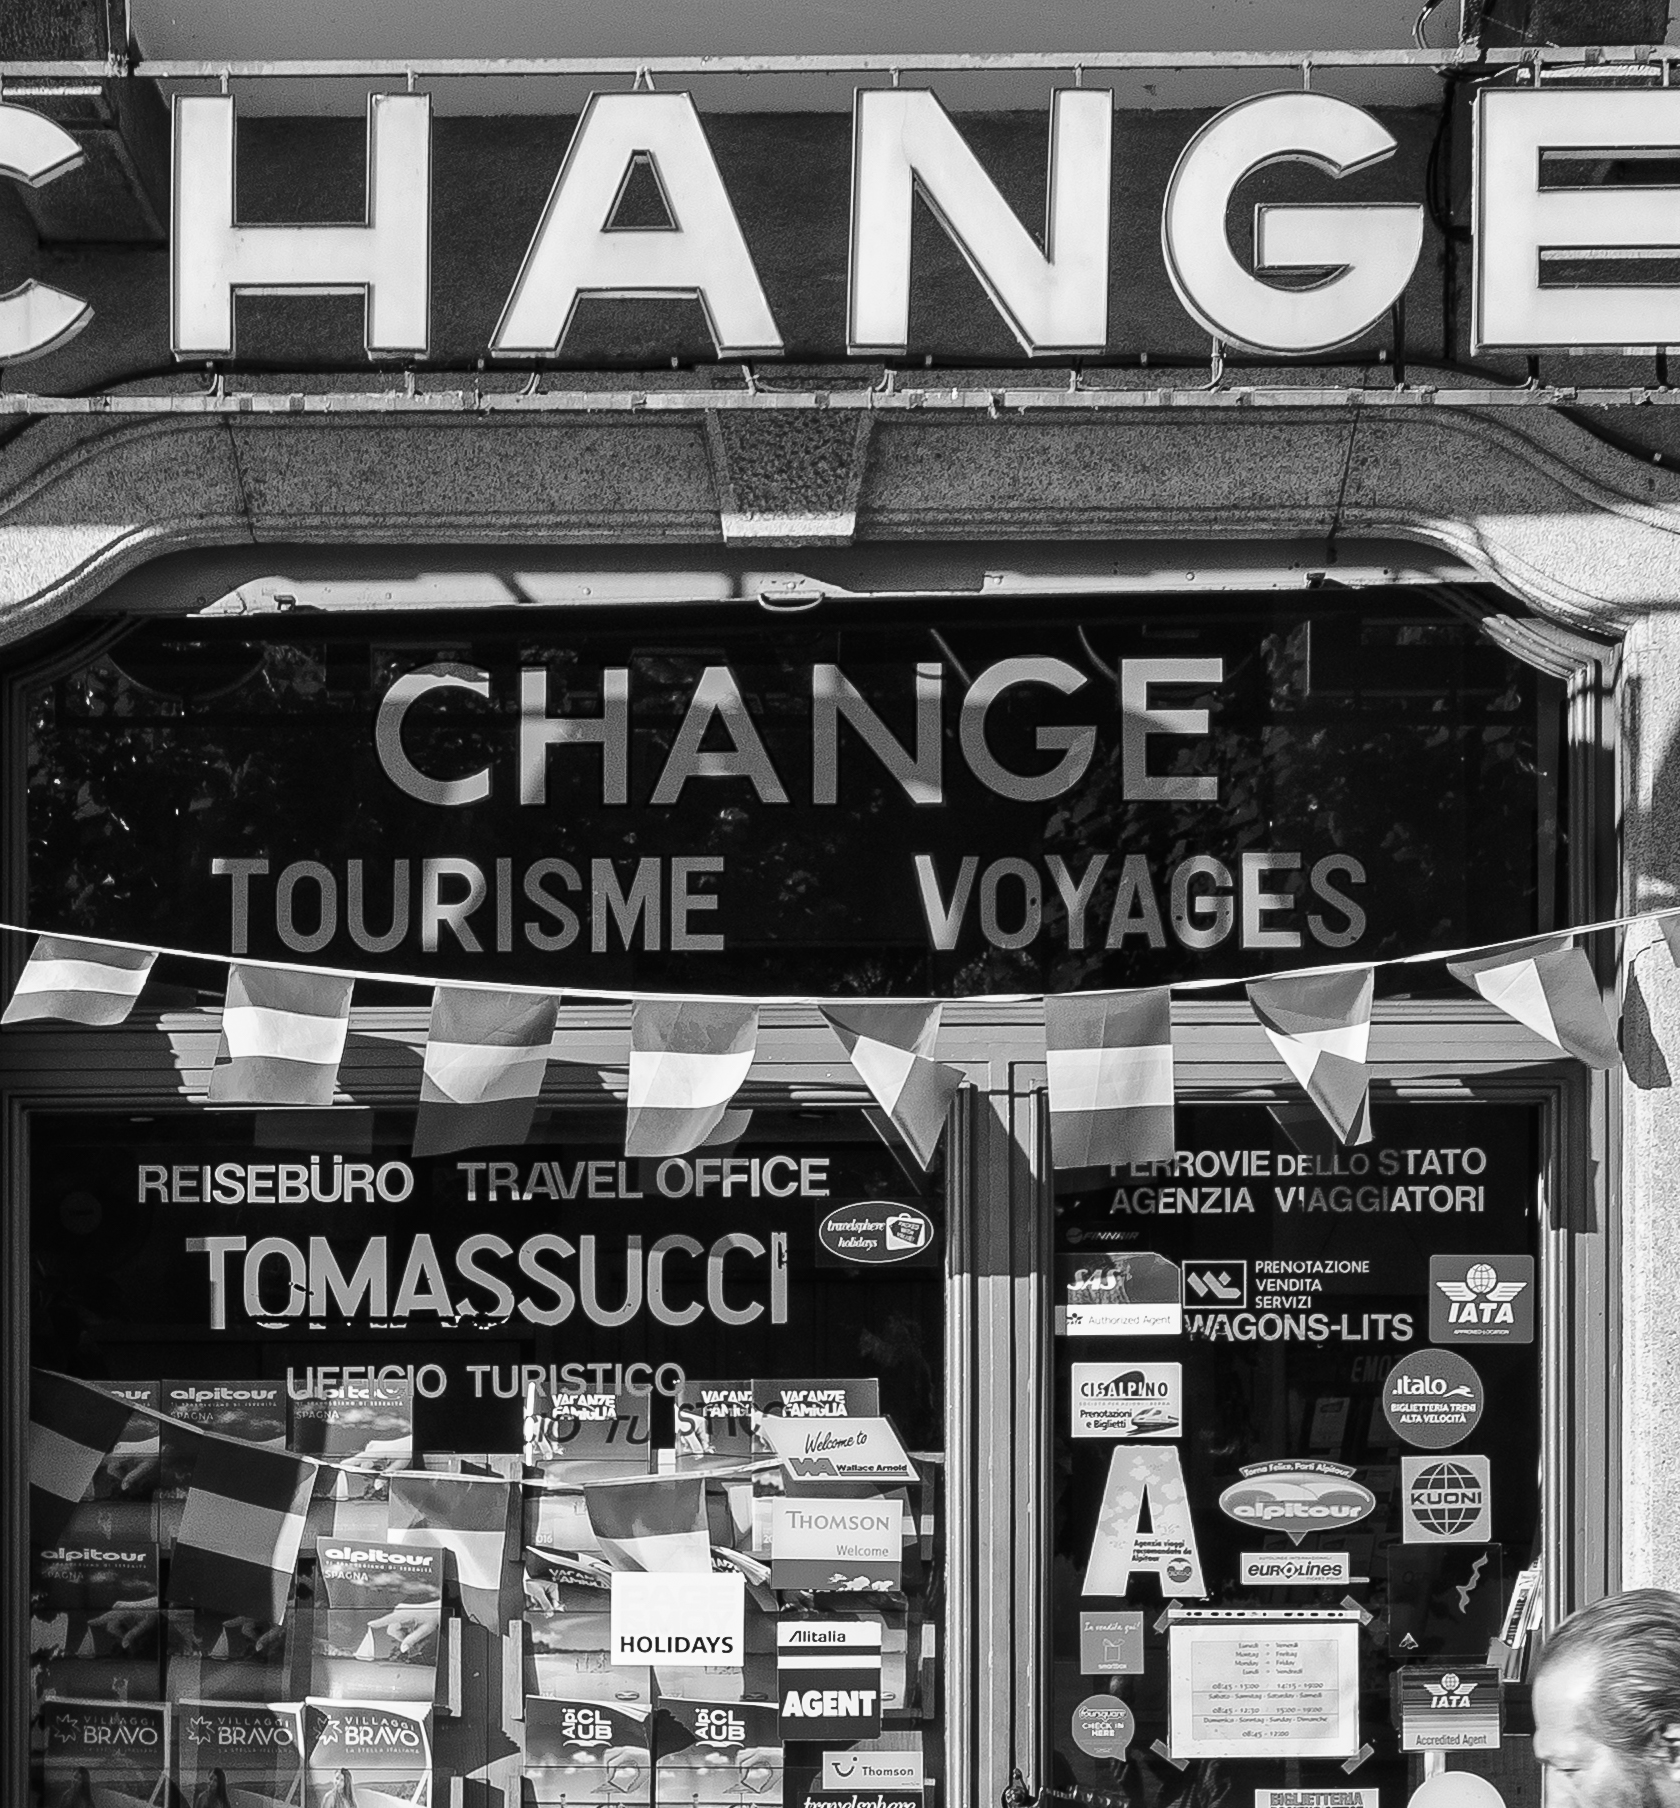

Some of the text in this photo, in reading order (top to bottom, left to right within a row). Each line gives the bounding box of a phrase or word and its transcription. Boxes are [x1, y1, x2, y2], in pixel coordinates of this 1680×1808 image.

[373, 657, 1225, 806] CHANGE
[211, 851, 1368, 955] TOURISME VOYAGES
[1276, 1154, 1370, 1177] DELLO
[1378, 1147, 1487, 1176] STATO
[137, 1154, 830, 1204] REISEBÜRO TRAVEL OFFICE
[1109, 1185, 1485, 1215] AGENZIA VIAGGIATORI
[838, 1237, 878, 1252] holidays
[1255, 1260, 1370, 1274] PRENOTAZIONE
[186, 1231, 789, 1331] TOMASSUCCI
[1067, 1268, 1121, 1290] SAS
[1256, 1279, 1322, 1292] VENDITA
[1255, 1296, 1312, 1309] SERVIZI
[1448, 1302, 1515, 1324] IATA
[1088, 1316, 1171, 1327] Authorized Agent
[1184, 1313, 1414, 1341] WAGONS-LITS
[286, 1362, 686, 1400] UFFICIO TURISTICO
[170, 1387, 277, 1402] alpitour
[780, 1390, 846, 1404] VACANZE
[1080, 1382, 1168, 1397] CISALPINO
[552, 1394, 616, 1406] VACANZE
[170, 1409, 214, 1422] SPAGNA
[296, 1409, 339, 1421] SPAGNA
[1080, 1408, 1132, 1419] Prenotazioni
[1390, 1403, 1477, 1413] BIGLIETTERIA TRENI
[1094, 1419, 1127, 1431] Biglietti
[1400, 1412, 1467, 1423] ALTA VELOCITÀ
[804, 1430, 868, 1455] Welcome to
[836, 1464, 874, 1472] Wallace
[876, 1464, 908, 1472] Arnold
[1410, 1488, 1482, 1506] KUONI
[1233, 1502, 1362, 1520] alpitour
[785, 1510, 890, 1531] THOMSON
[41, 1548, 147, 1563] alpitour
[324, 1546, 434, 1567] alpitour
[835, 1544, 890, 1558] Welcome
[324, 1569, 369, 1582] SPAGNA
[620, 1636, 734, 1654] HOLIDAYS
[788, 1631, 847, 1644] Alitalia
[782, 1690, 877, 1718] AGENT
[1430, 1695, 1471, 1709] IATA
[218, 1716, 289, 1728] VILLAGGI
[345, 1716, 415, 1731] VILLAGGI
[83, 1727, 159, 1746] BRAVO
[219, 1726, 293, 1746] BRAVO
[345, 1726, 420, 1747] BRAVO
[1091, 1729, 1115, 1737] HERE
[1416, 1733, 1487, 1747] Accredited Agent
[862, 1766, 914, 1777] Thomson
[1270, 1792, 1364, 1806] BIGLIETTERIA
